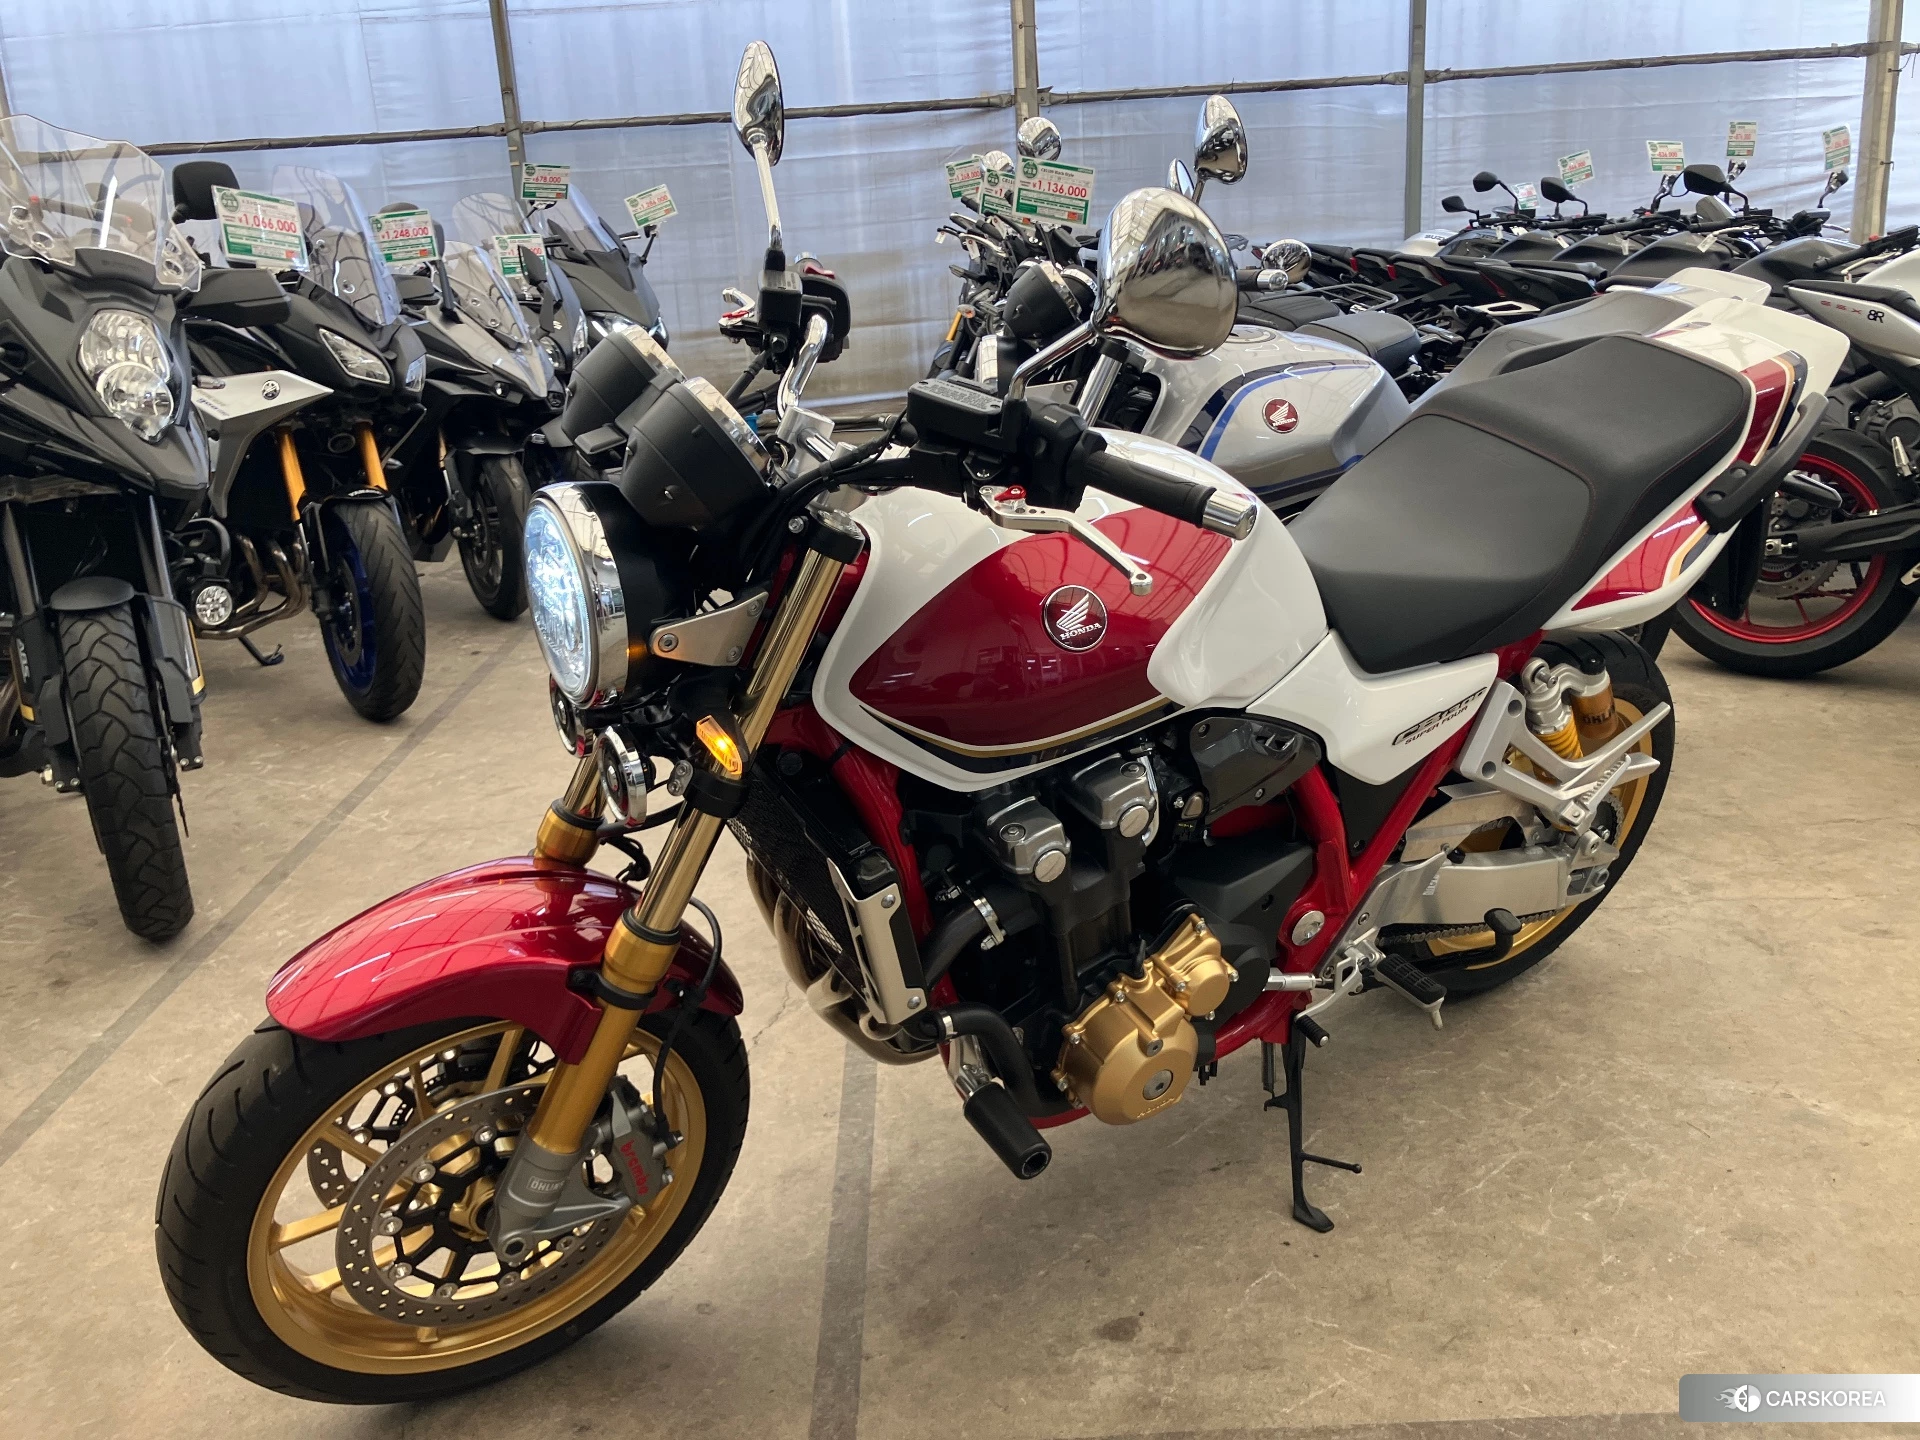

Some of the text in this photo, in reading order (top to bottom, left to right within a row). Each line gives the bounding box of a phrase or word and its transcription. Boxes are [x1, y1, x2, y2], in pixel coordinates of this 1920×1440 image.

[1032, 179, 1087, 198] ¥1,136,000
[238, 213, 297, 233] ¥1,066,000
[381, 226, 429, 239] ¥1,248,000
[1867, 309, 1884, 323] 8R
[1059, 622, 1103, 640] HONDA
[1404, 705, 1468, 745] SUPER FOUR
[620, 1138, 650, 1196] brembo
